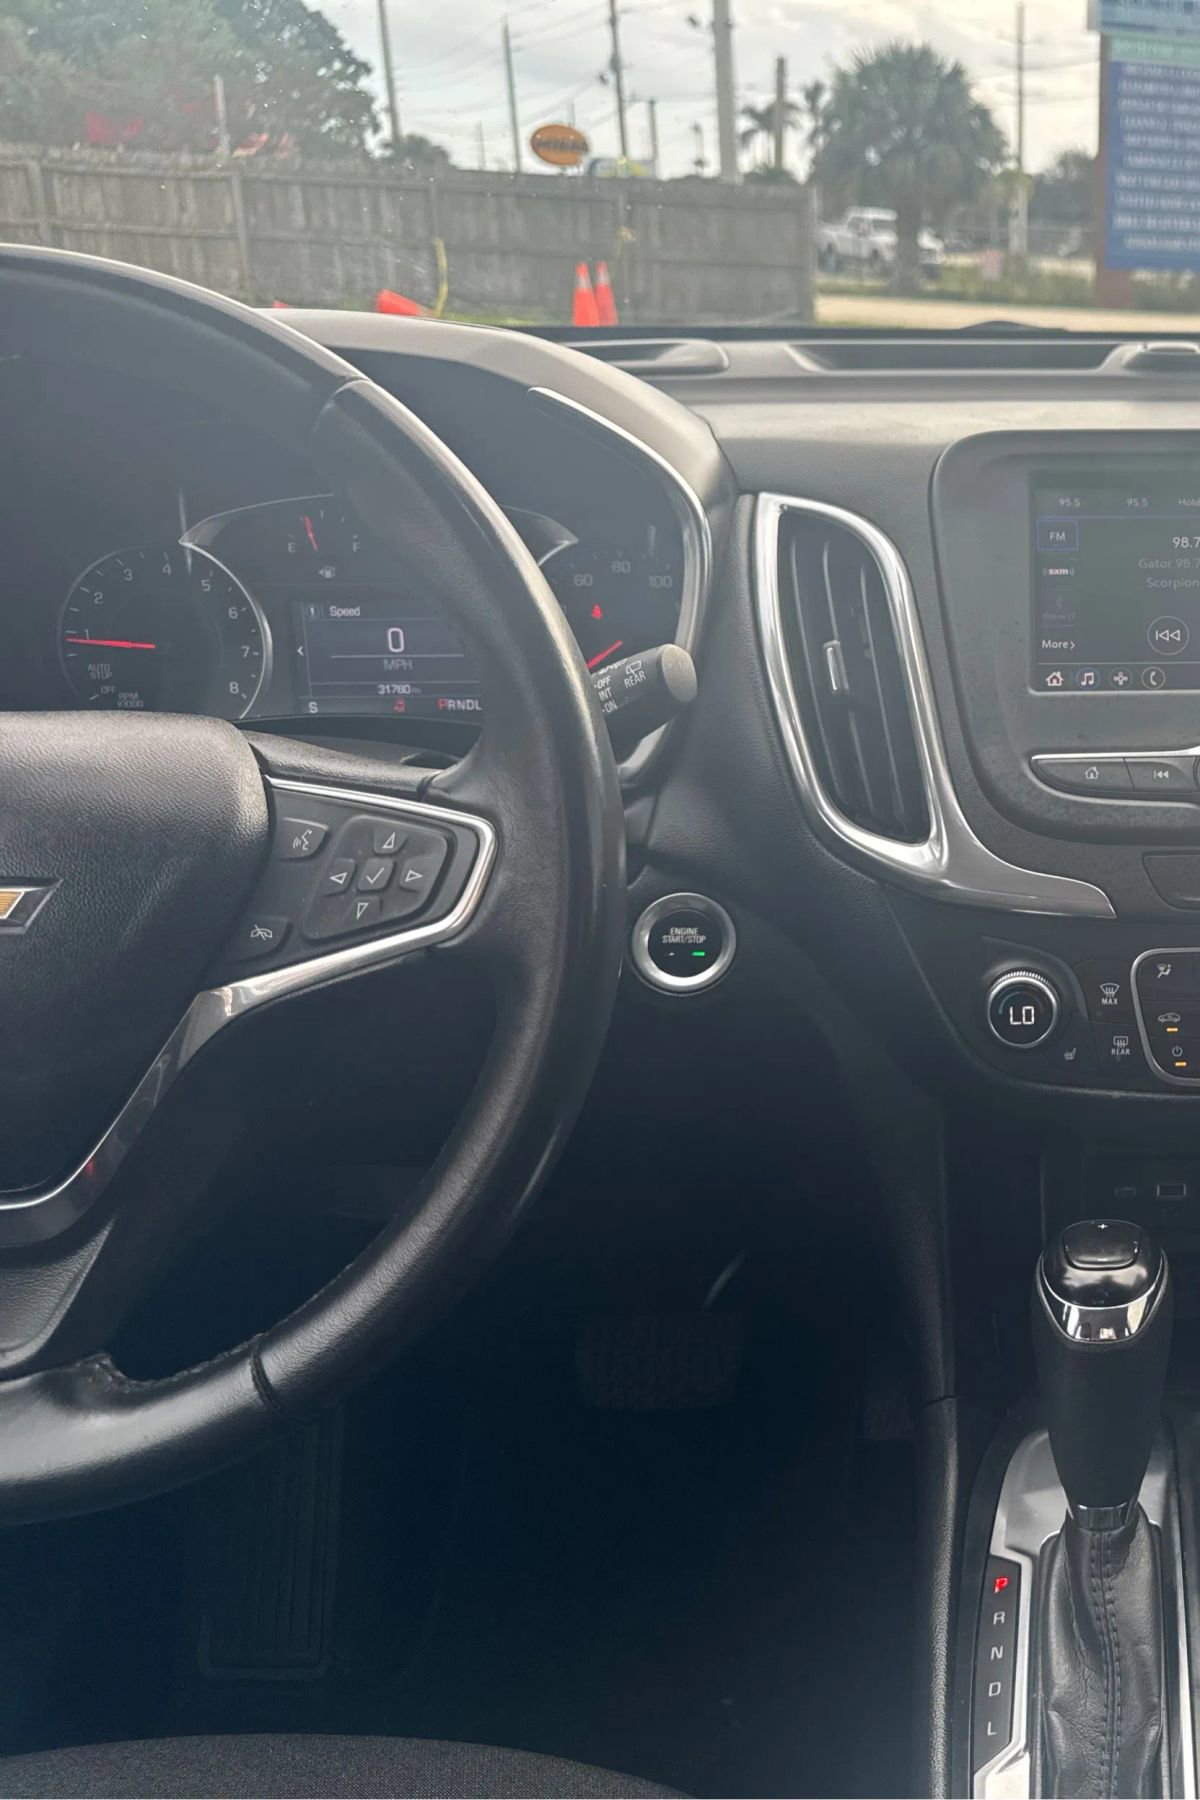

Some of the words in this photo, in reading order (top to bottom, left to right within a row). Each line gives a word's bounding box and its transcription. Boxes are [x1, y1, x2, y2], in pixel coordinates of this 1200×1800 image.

[1058, 498, 1081, 508] 95.5
[1126, 498, 1148, 508] 95.5
[1178, 498, 1200, 507] Hold
[1049, 531, 1066, 542] FM
[1172, 536, 1200, 549] 98.7
[161, 563, 172, 575] 4
[611, 560, 632, 574] 80
[1138, 558, 1172, 569] Gator
[1175, 558, 1200, 569] 98.7
[123, 568, 134, 581] 3
[1048, 567, 1069, 576] sxm
[201, 579, 211, 592] 5
[574, 574, 594, 587] 60
[648, 575, 673, 589] 100
[93, 592, 104, 605] 2
[228, 607, 239, 620] 6
[329, 605, 361, 617] Speed
[387, 627, 405, 653] 0
[1041, 639, 1069, 649] More
[241, 646, 251, 658] 7
[384, 659, 413, 671] MPH
[624, 670, 647, 689] REAR
[229, 682, 240, 694] 8
[308, 701, 319, 714] S
[670, 927, 699, 935] ENGINE
[662, 935, 706, 944] START/STOP
[1101, 996, 1119, 1006] MAX
[1110, 1047, 1131, 1057] REAR
[995, 1576, 1009, 1593] P
[993, 1611, 1006, 1626] R
[990, 1646, 1003, 1660] N
[988, 1682, 1001, 1697] D
[987, 1722, 997, 1736] L
